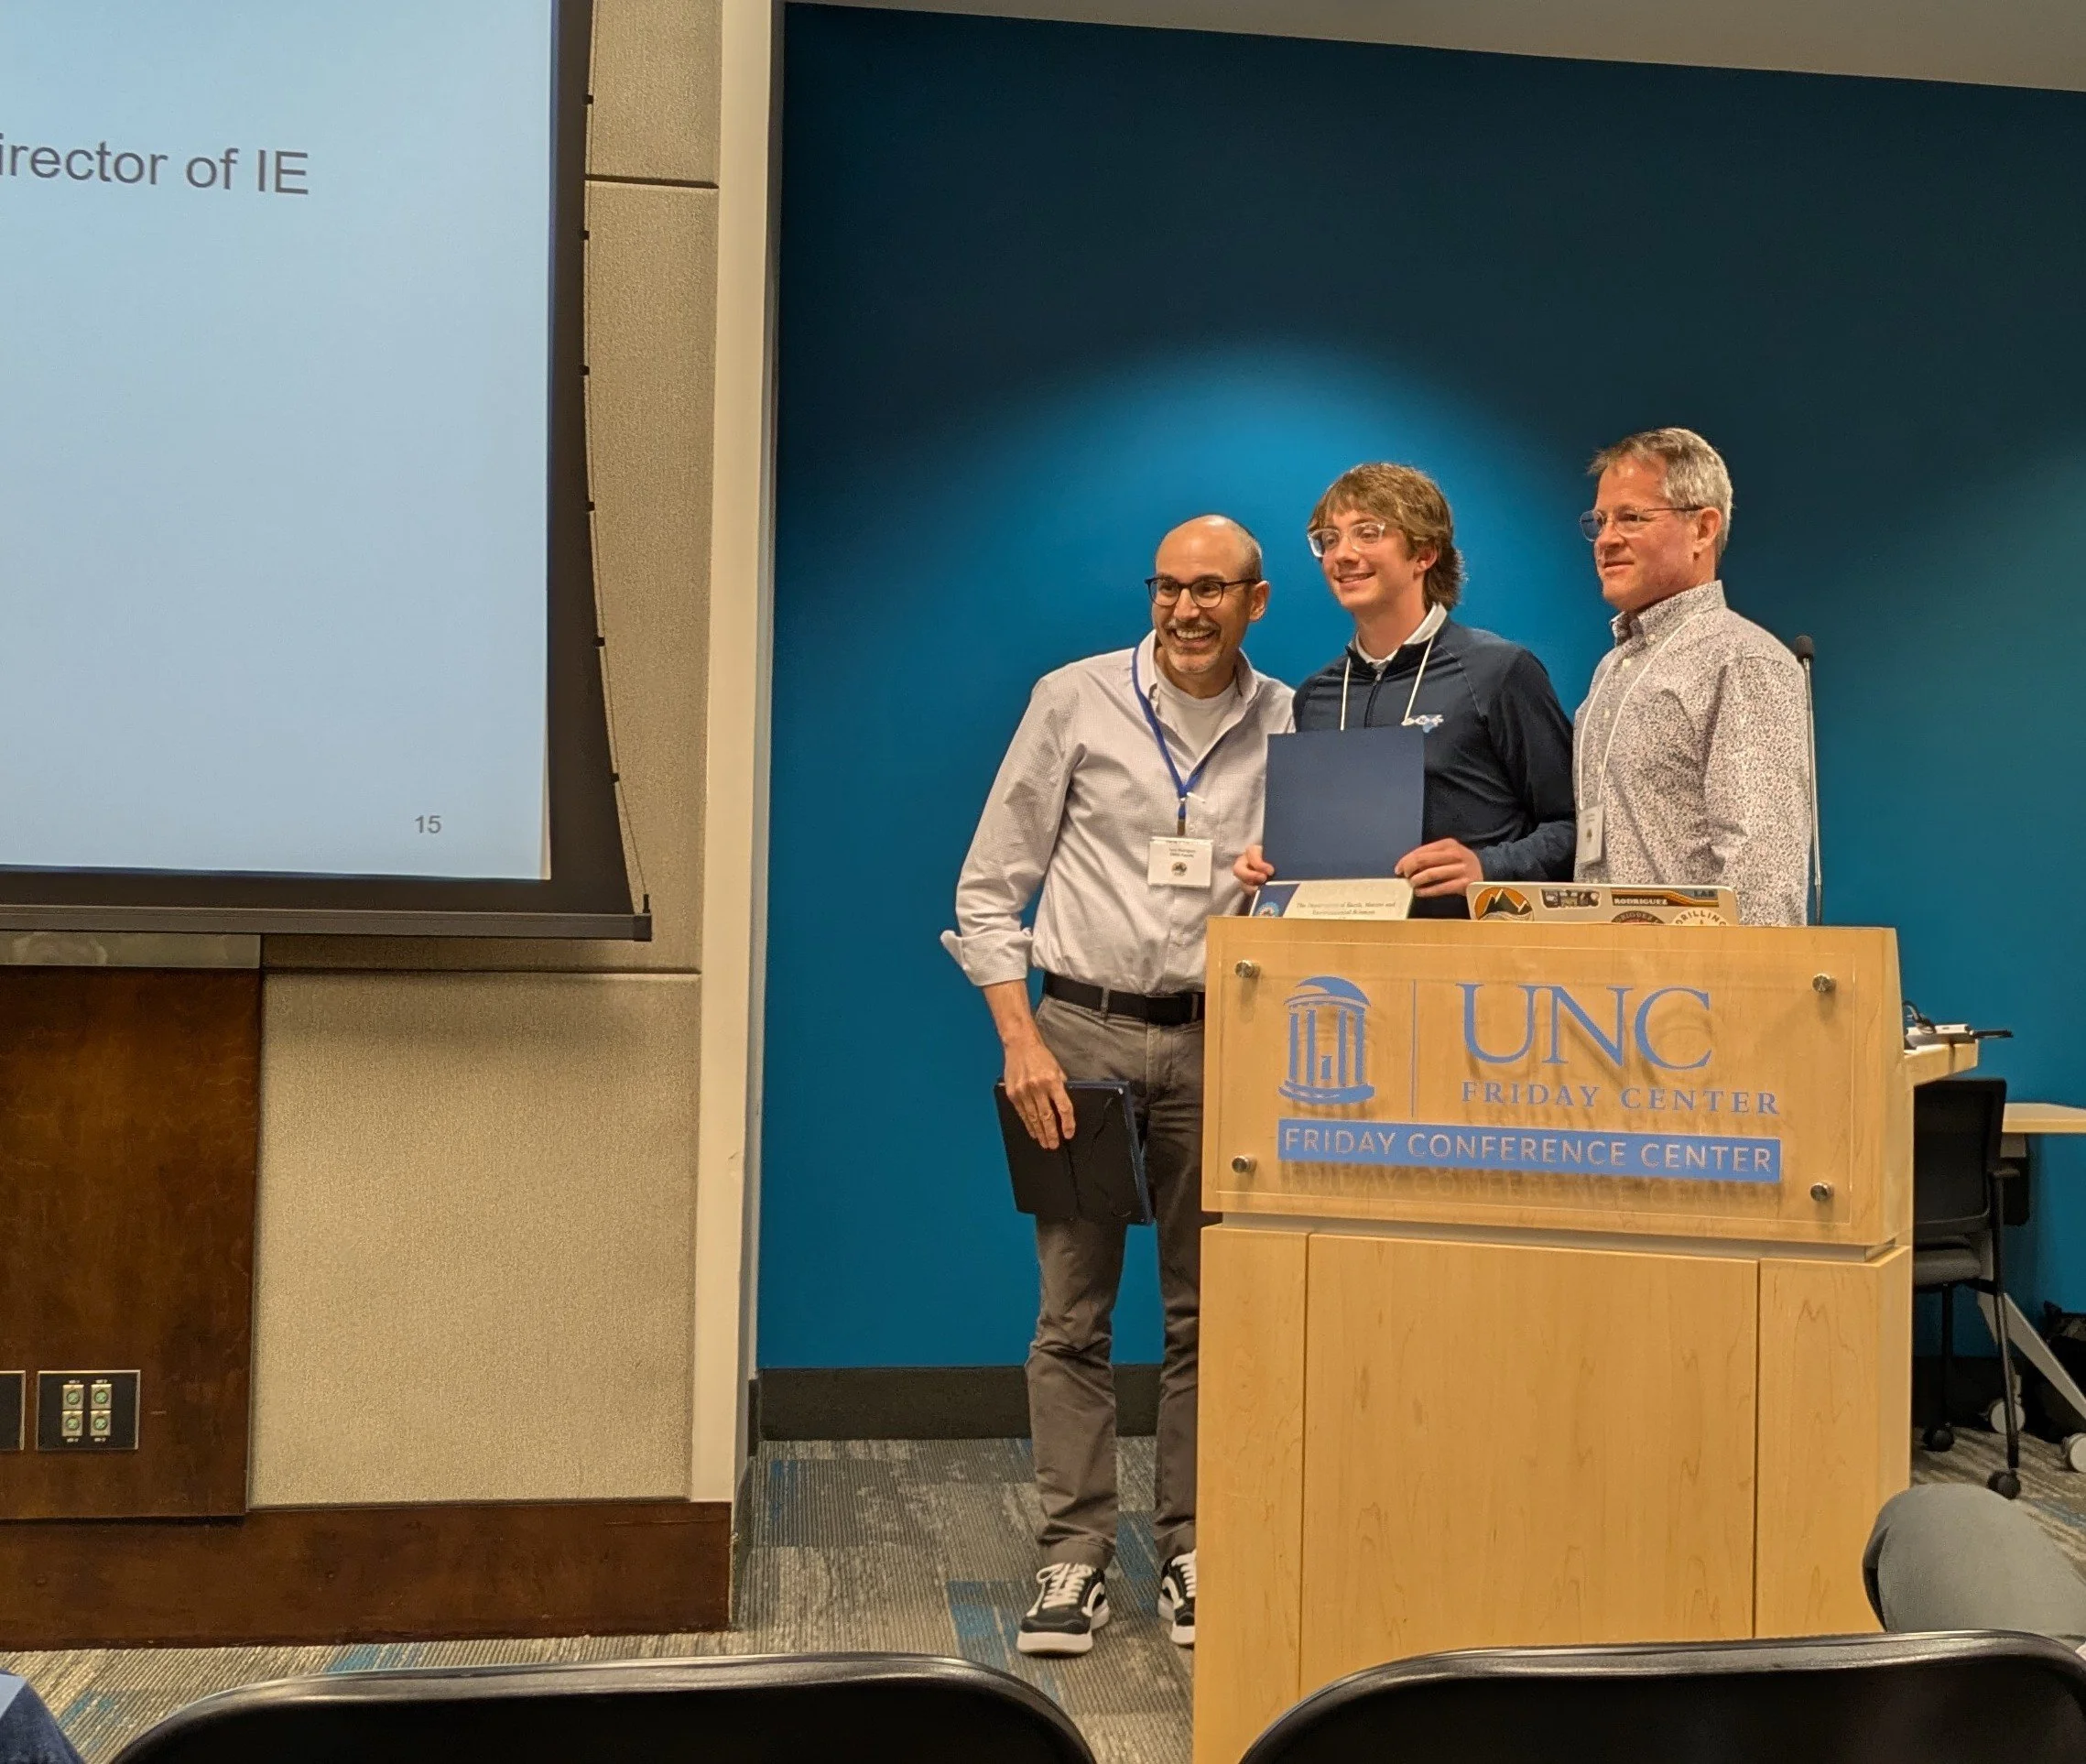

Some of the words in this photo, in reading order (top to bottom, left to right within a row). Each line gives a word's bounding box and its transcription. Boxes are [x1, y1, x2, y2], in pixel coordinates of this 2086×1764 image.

[186, 147, 240, 191] of
[257, 148, 310, 195] IE
[415, 814, 441, 833] 15
[1455, 982, 1712, 1071] UNC
[1461, 1080, 1602, 1108] FRIDAY
[1620, 1087, 1780, 1116] CENTER
[1284, 1127, 1396, 1155] FRIDAY
[1407, 1132, 1627, 1167] CONFERENCE
[1640, 1141, 1772, 1173] CENTER
